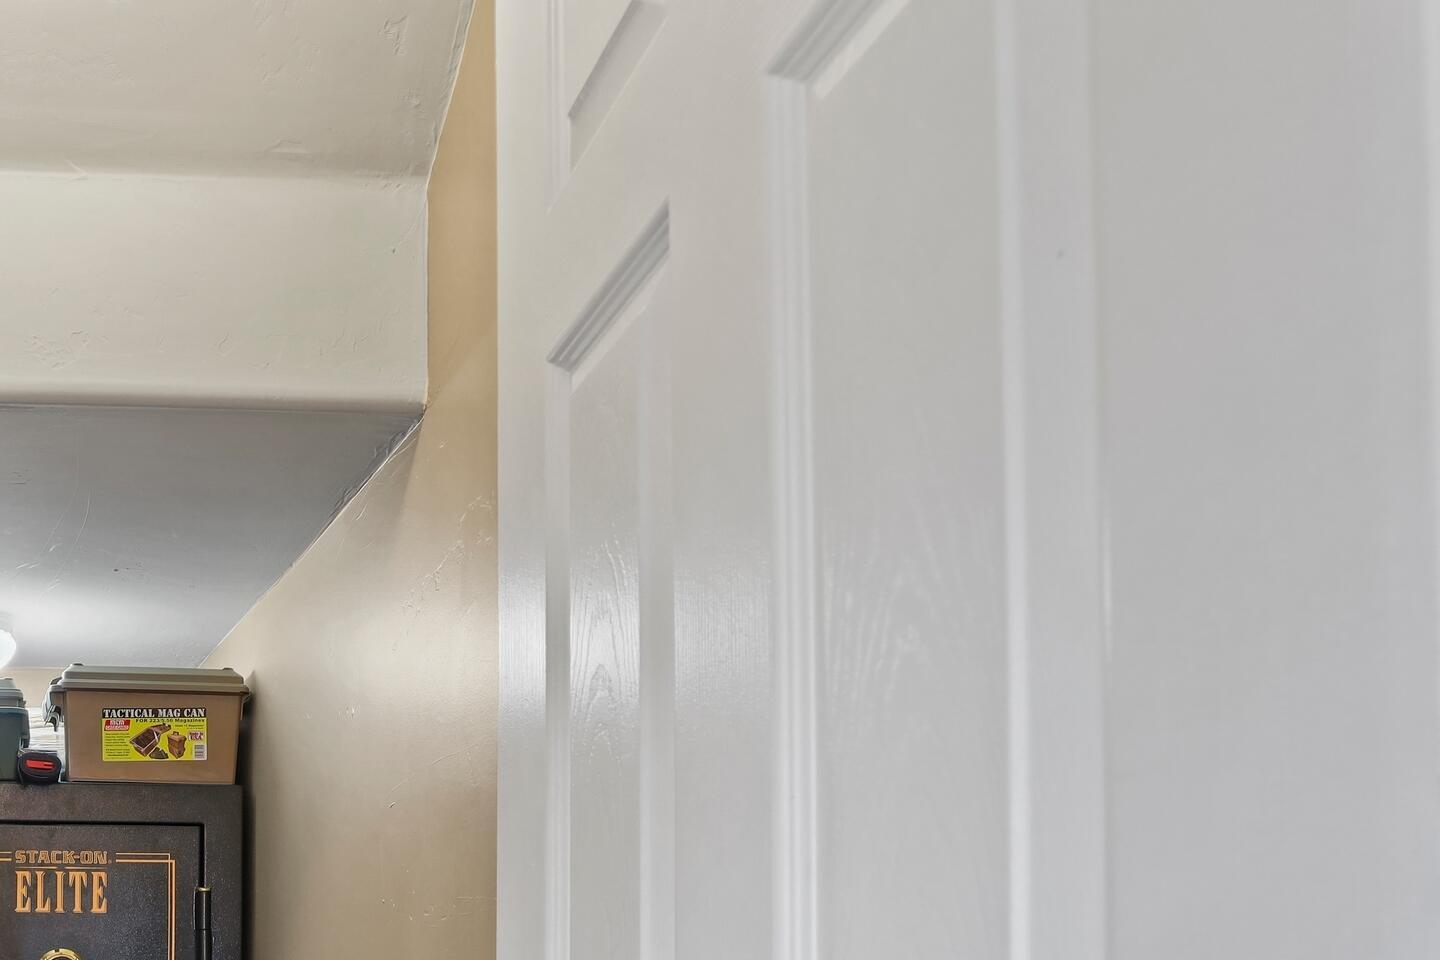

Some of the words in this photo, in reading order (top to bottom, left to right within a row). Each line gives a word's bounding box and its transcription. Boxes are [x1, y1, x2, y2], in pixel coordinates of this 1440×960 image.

[103, 708, 155, 718] TACTICAL
[157, 708, 181, 718] MAG
[183, 708, 206, 718] CAN
[15, 850, 108, 865] STACK-ON
[14, 870, 108, 914] ELITE
